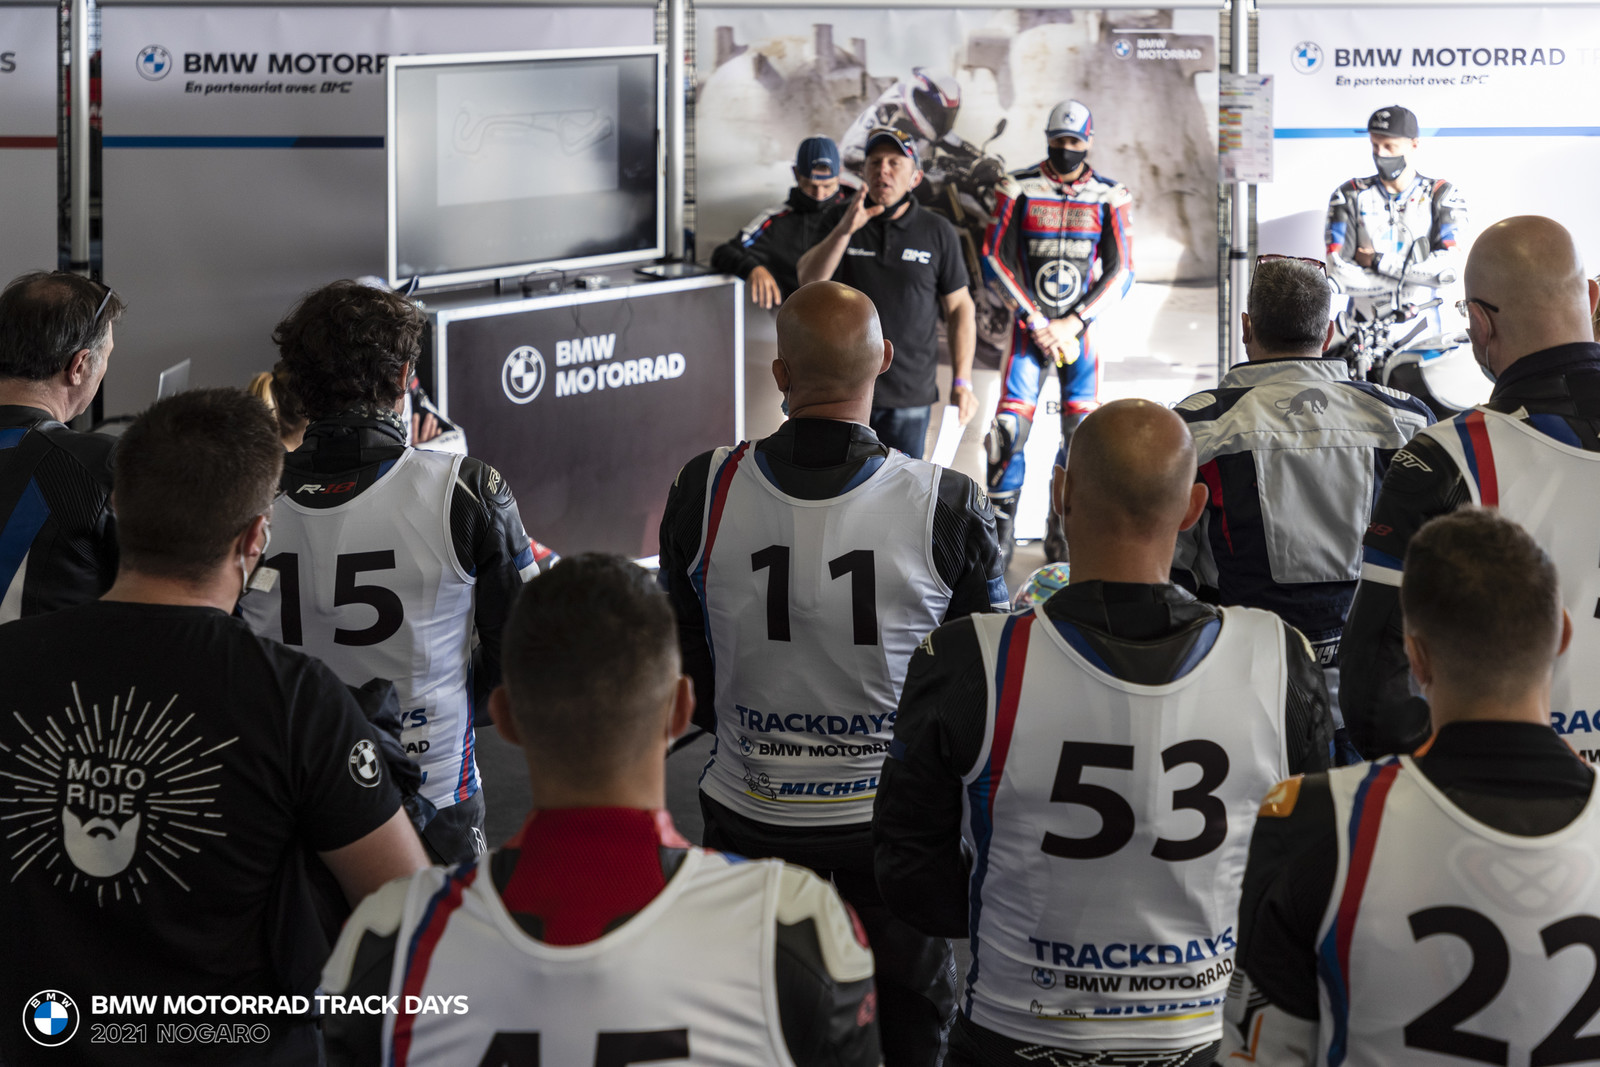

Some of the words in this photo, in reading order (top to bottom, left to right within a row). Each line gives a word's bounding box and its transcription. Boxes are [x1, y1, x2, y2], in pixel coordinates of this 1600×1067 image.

[1136, 49, 1202, 59] MOTORRAD
[1137, 38, 1167, 48] BMW
[183, 53, 258, 74] BMW
[267, 53, 389, 74] MOTORR
[1334, 48, 1402, 67] BMW
[1412, 48, 1566, 67] MOTORRAD
[184, 81, 202, 93] En
[204, 81, 283, 95] partenariat
[285, 83, 317, 94] avec
[1335, 75, 1351, 86] En
[1353, 75, 1425, 88] partenariat
[1428, 77, 1456, 86] avec
[556, 333, 616, 367] BMW
[555, 352, 686, 398] MOTORRAD
[295, 481, 356, 495] R-18
[264, 549, 404, 647] 15
[750, 544, 878, 646] 11
[759, 743, 803, 757] BMW
[66, 758, 146, 790] MOTO
[779, 776, 879, 796] MICHEL
[66, 783, 135, 815] RIDE
[1040, 739, 1230, 862] 53
[1028, 926, 1237, 970] TRACKDAYS
[1064, 974, 1121, 992] BMW
[1129, 958, 1234, 992] MOTORRAD
